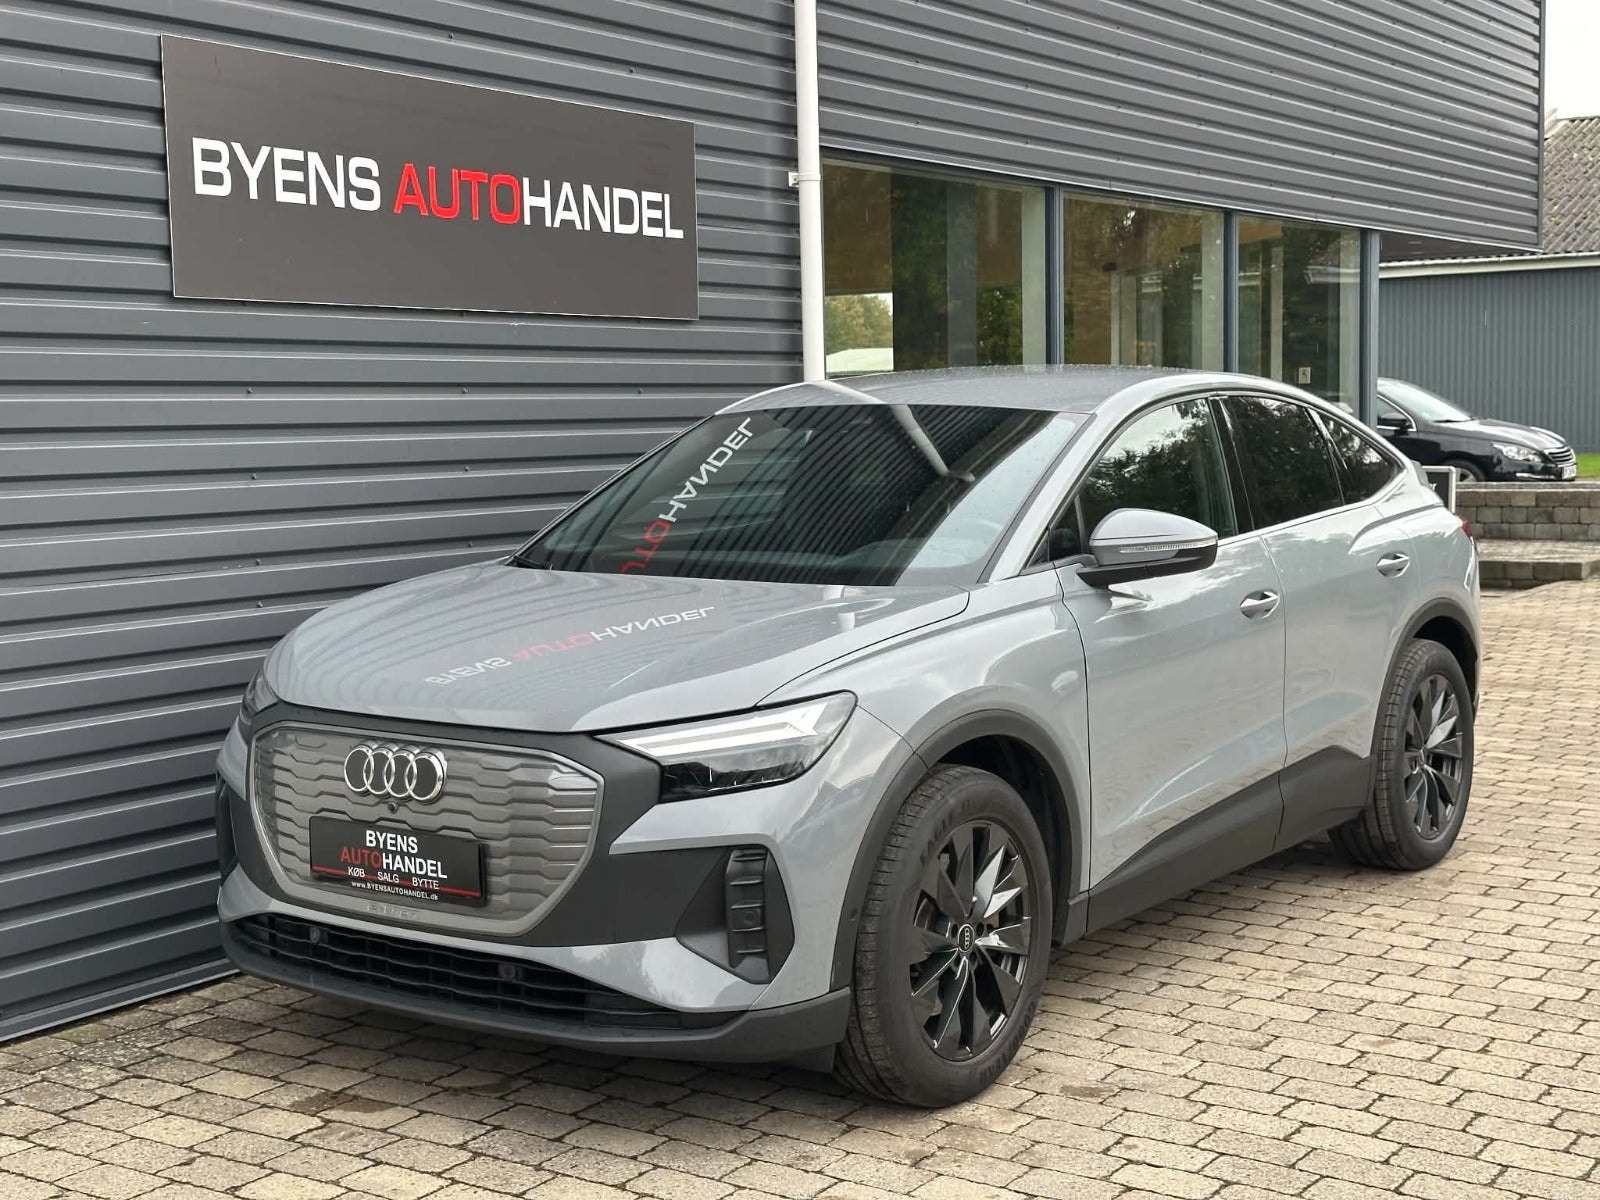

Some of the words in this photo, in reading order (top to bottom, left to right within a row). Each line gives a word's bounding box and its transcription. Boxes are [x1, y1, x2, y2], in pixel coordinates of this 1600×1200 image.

[192, 137, 380, 211] BYENS
[394, 163, 683, 239] AUTOHANDEL
[365, 830, 418, 853] BYENS
[340, 847, 448, 879] AUTOHANDEL
[348, 867, 366, 878] KØB
[377, 872, 400, 884] SALG
[412, 877, 440, 890] BYTTE
[351, 881, 439, 901] www.BYENSAUTOHANDEL.dk
